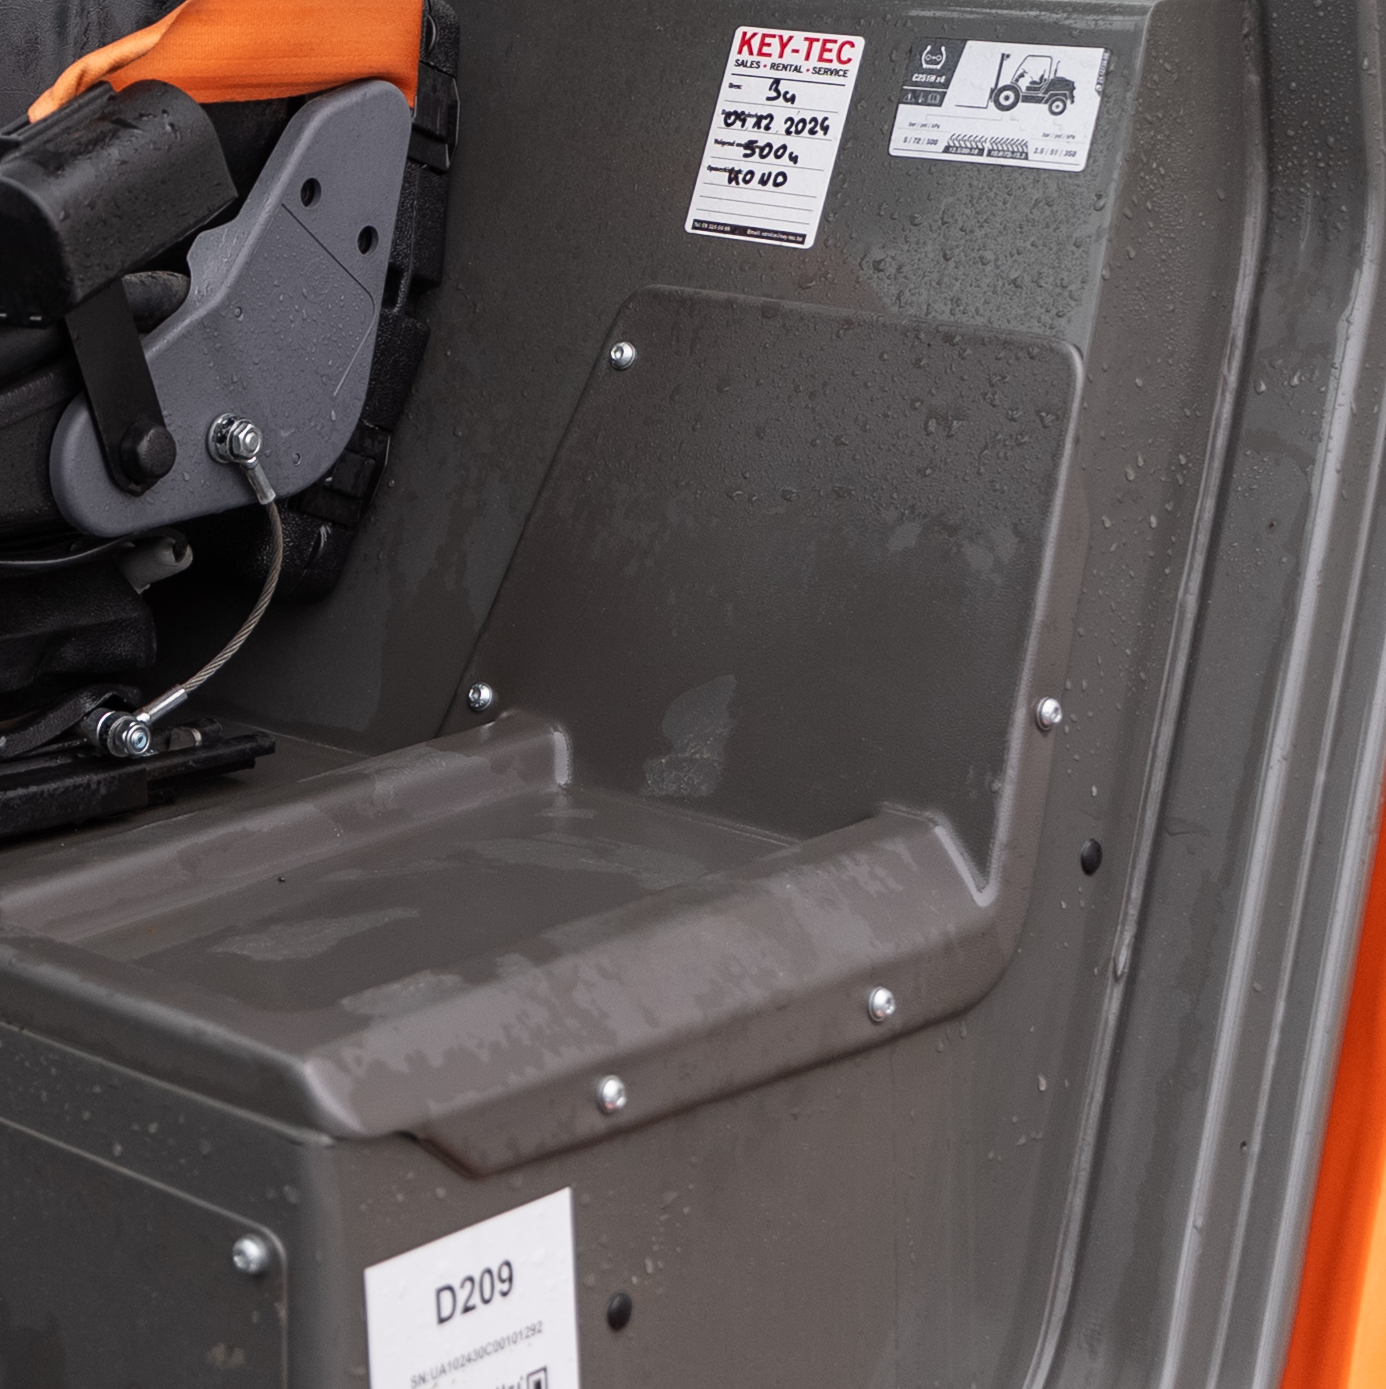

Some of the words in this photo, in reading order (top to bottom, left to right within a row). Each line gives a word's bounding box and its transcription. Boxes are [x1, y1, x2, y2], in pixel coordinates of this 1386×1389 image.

[736, 31, 856, 66] KEY-TEC
[734, 58, 761, 70] SALES
[769, 62, 804, 74] RENTAL
[811, 66, 849, 78] SERVICE
[435, 1260, 514, 1325] D209
